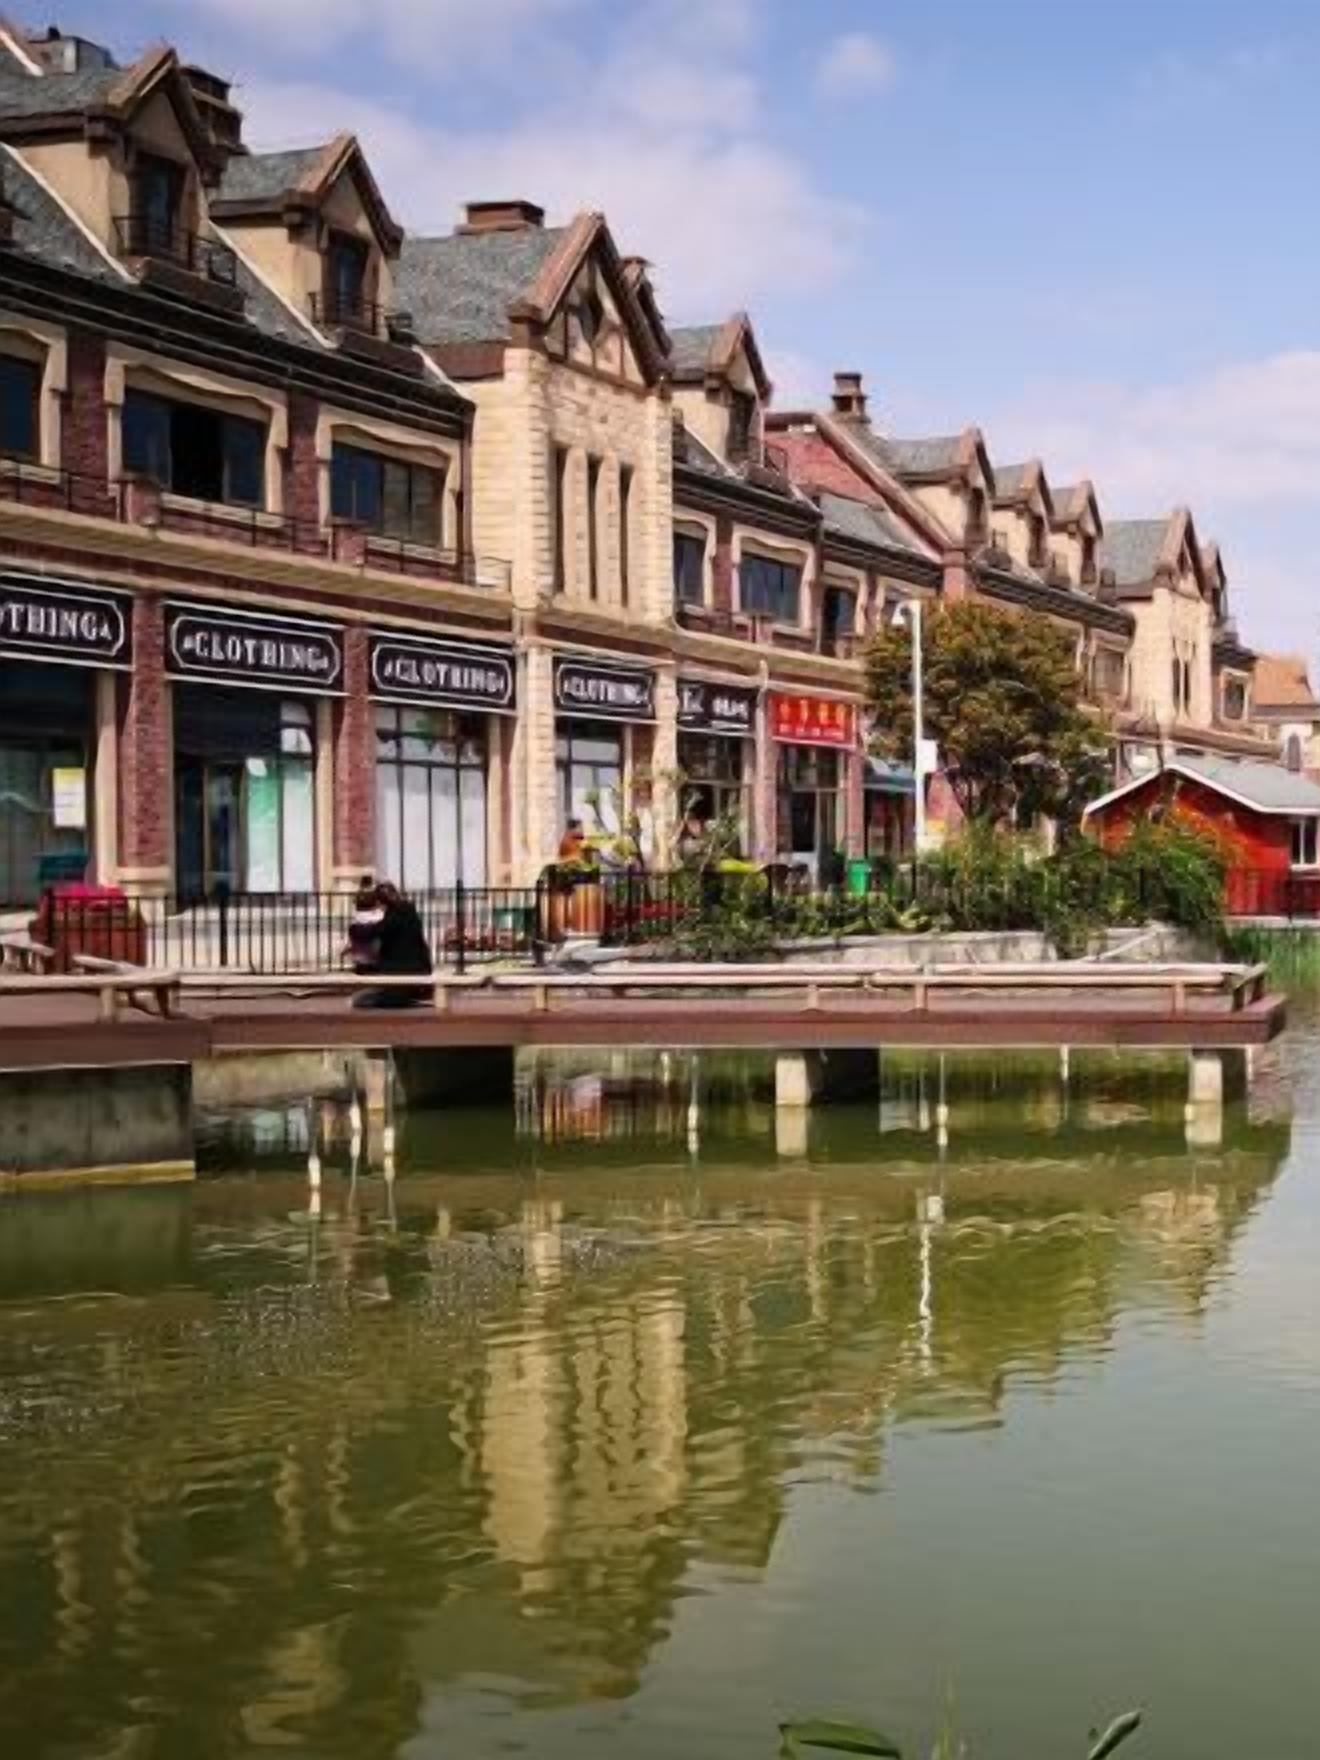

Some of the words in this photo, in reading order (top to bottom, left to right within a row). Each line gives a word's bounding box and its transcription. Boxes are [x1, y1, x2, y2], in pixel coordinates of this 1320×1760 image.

[0, 602, 98, 641] THING
[195, 631, 321, 671] CLOTHING
[396, 657, 497, 692] CLOTHING
